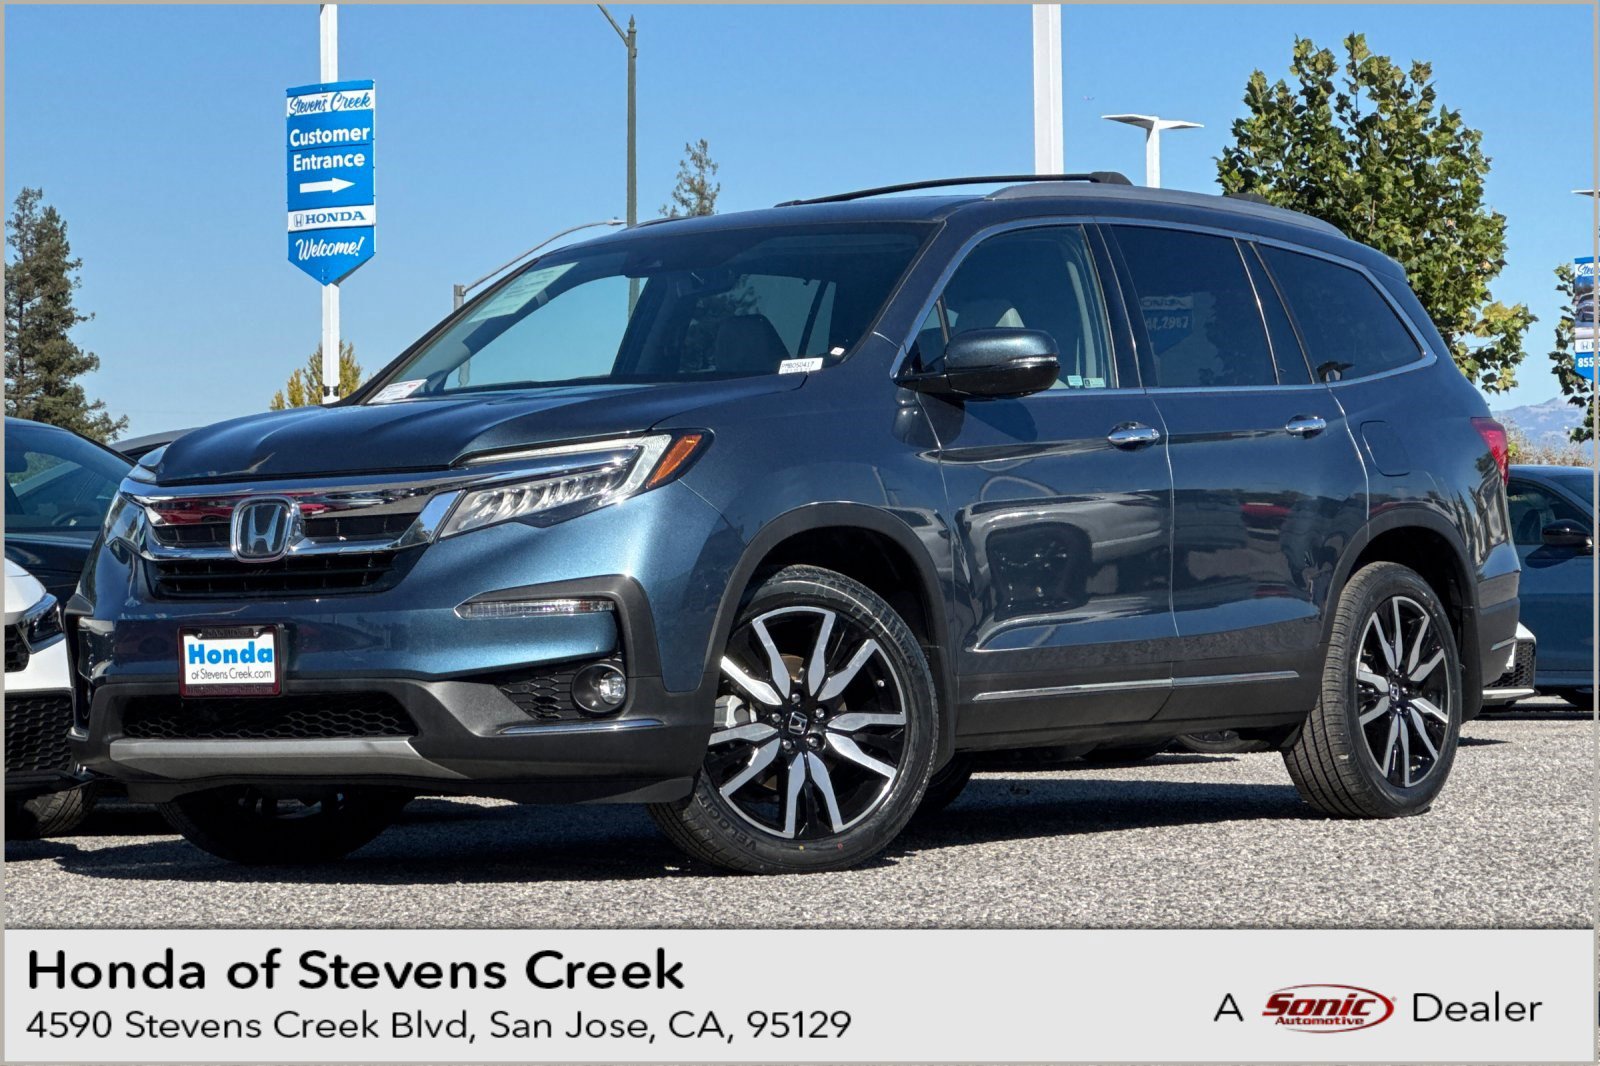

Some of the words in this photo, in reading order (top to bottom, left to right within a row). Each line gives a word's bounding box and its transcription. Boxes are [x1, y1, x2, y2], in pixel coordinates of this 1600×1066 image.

[289, 96, 328, 116] Stevens
[330, 92, 371, 111] Creek
[290, 126, 370, 147] Customer
[293, 152, 365, 172] Entrance
[305, 210, 365, 224] HONDA
[295, 236, 365, 261] Welcome!
[188, 641, 273, 664] Honda
